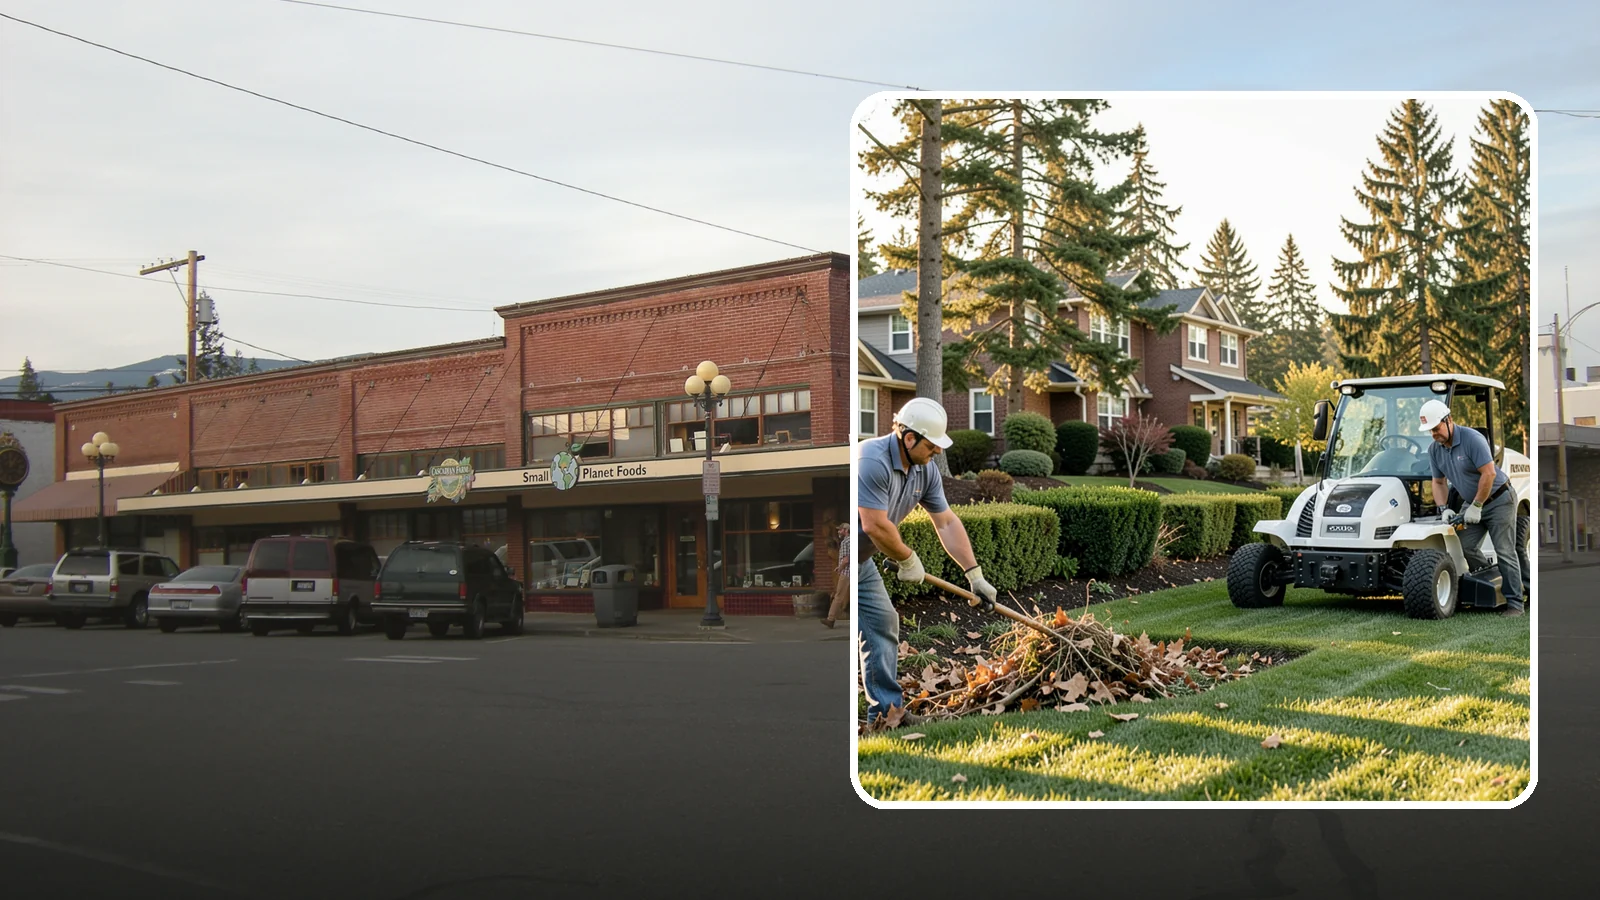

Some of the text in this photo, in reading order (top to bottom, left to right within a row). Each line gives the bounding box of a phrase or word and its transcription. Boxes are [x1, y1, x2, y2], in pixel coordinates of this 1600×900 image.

[523, 464, 647, 483] Small Planet Foods
